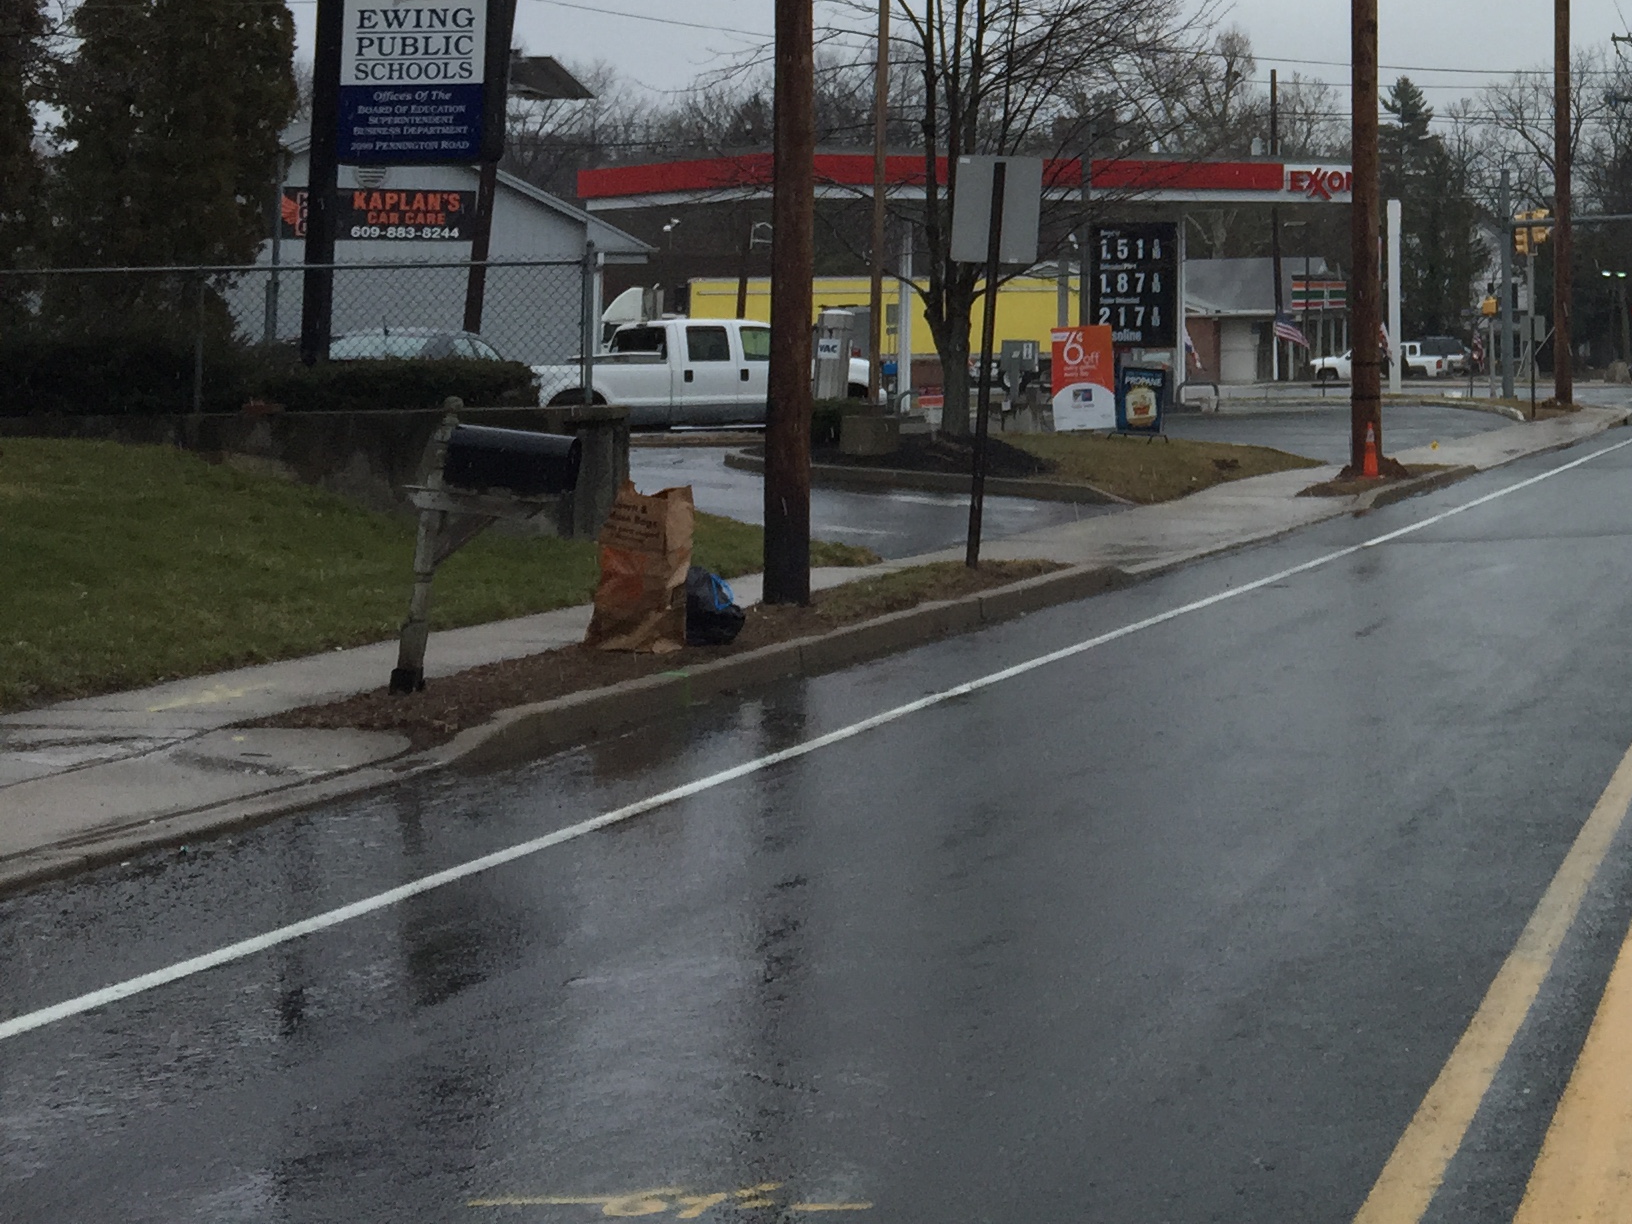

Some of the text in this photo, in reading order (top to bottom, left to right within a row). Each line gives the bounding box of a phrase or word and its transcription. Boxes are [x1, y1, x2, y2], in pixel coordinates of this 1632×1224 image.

[356, 7, 475, 29] EWING
[355, 35, 474, 57] PUBLIC
[354, 61, 473, 81] SCHOOLS
[373, 90, 452, 103] Offices Of The
[410, 105, 467, 114] EDUCATION
[441, 140, 470, 150] ROAD
[352, 190, 461, 212] KAPLAN'S
[367, 211, 446, 225] CAR CARE
[350, 226, 460, 239] 609-883-8244
[1112, 328, 1142, 342] soline
[819, 344, 838, 353] VAC
[1124, 376, 1162, 387] PROPANE
